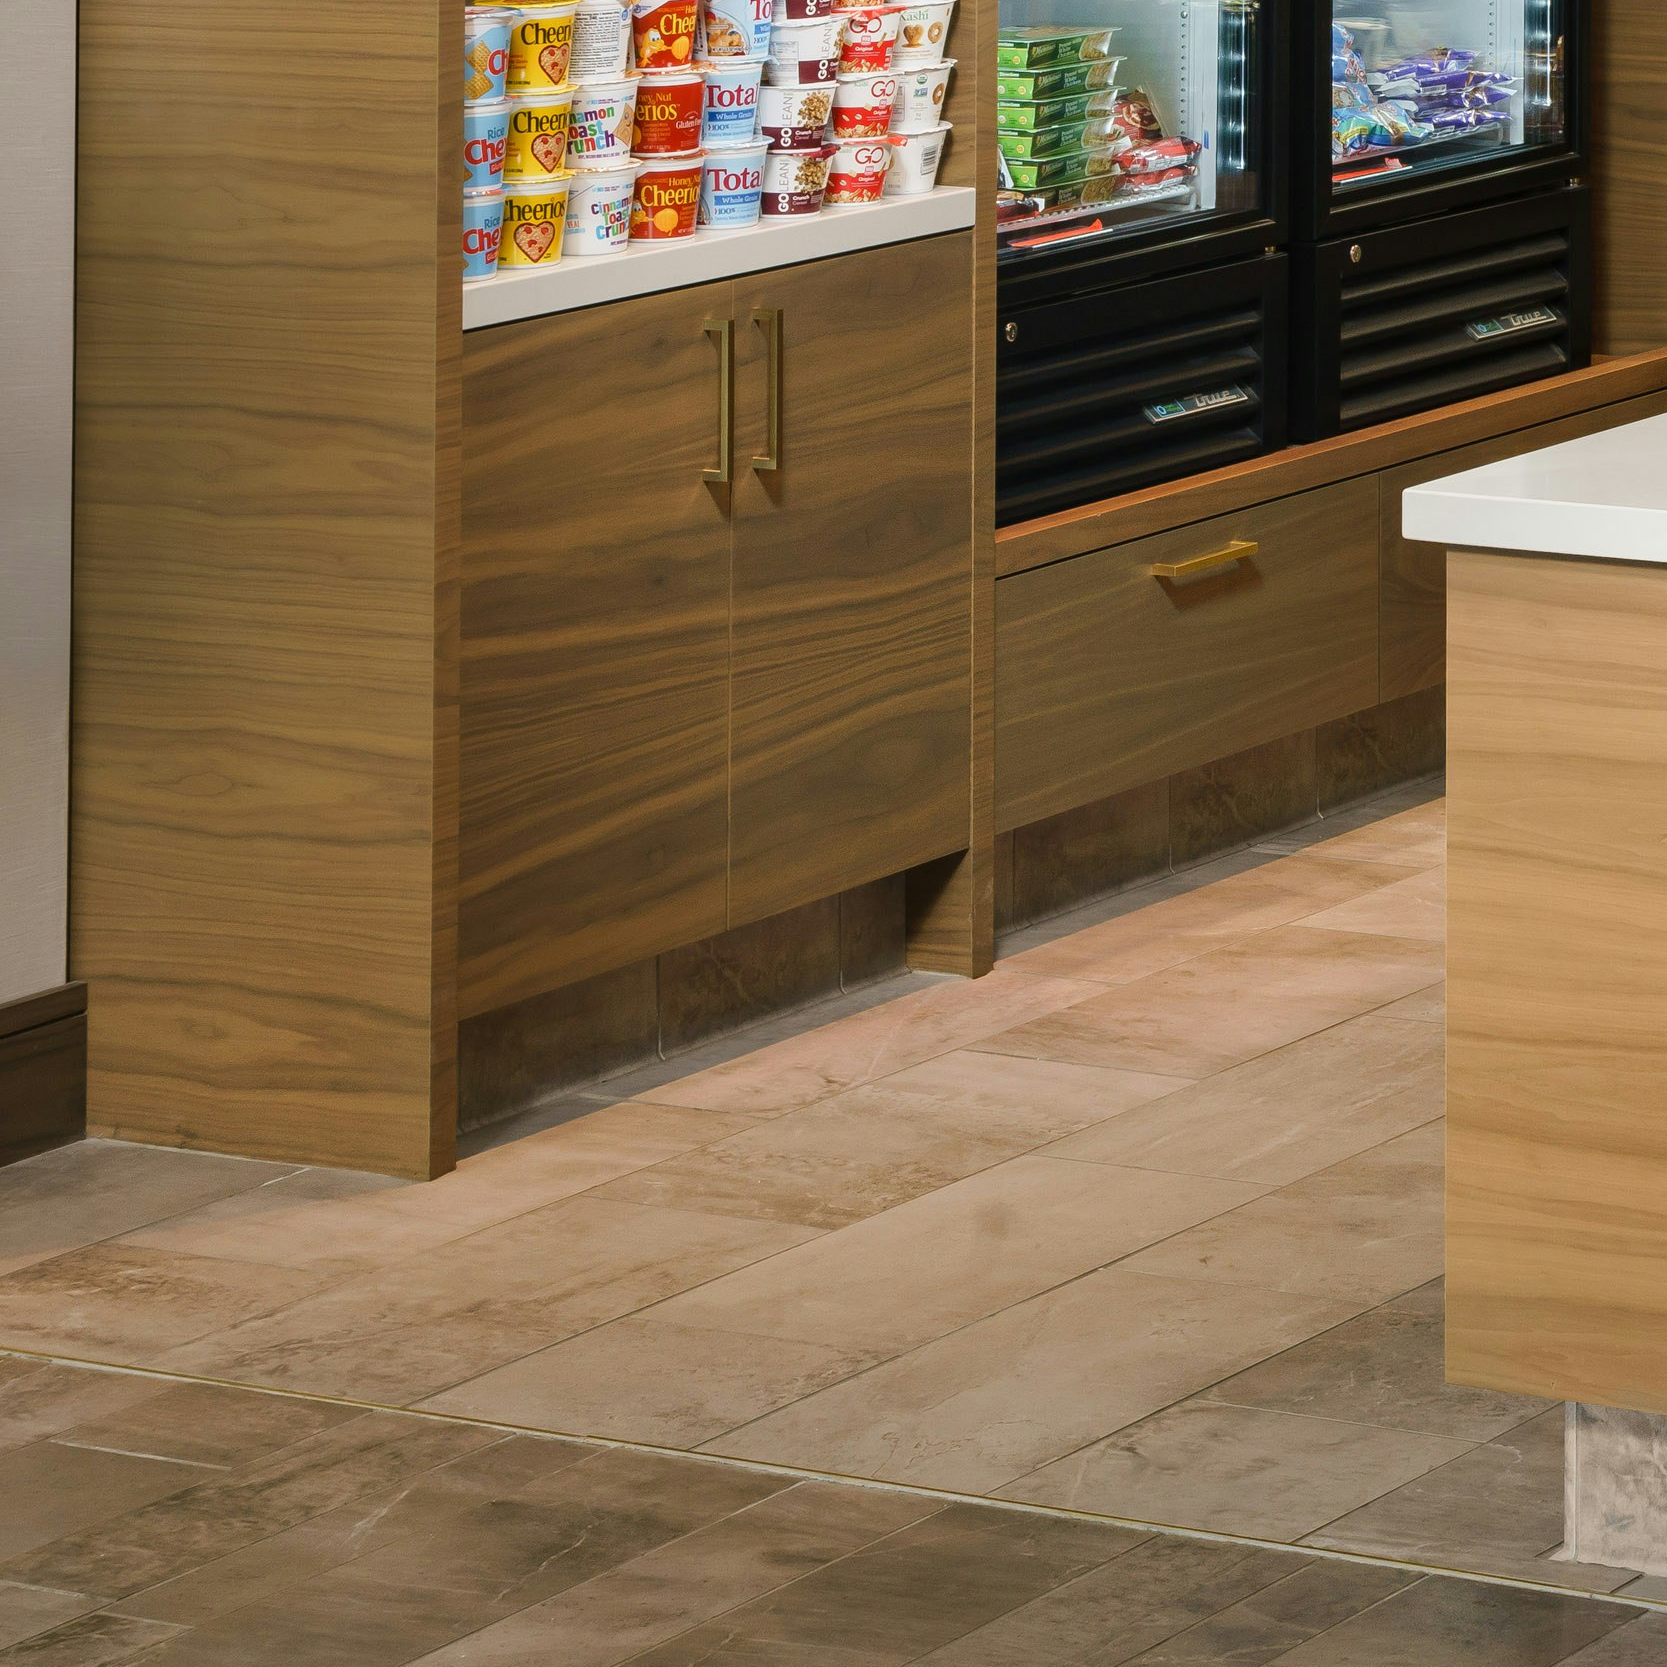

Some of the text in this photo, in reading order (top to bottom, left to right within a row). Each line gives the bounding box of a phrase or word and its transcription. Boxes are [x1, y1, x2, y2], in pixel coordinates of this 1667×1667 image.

[705, 84, 759, 108] Total
[488, 127, 505, 140] Rice
[855, 146, 884, 164] GO
